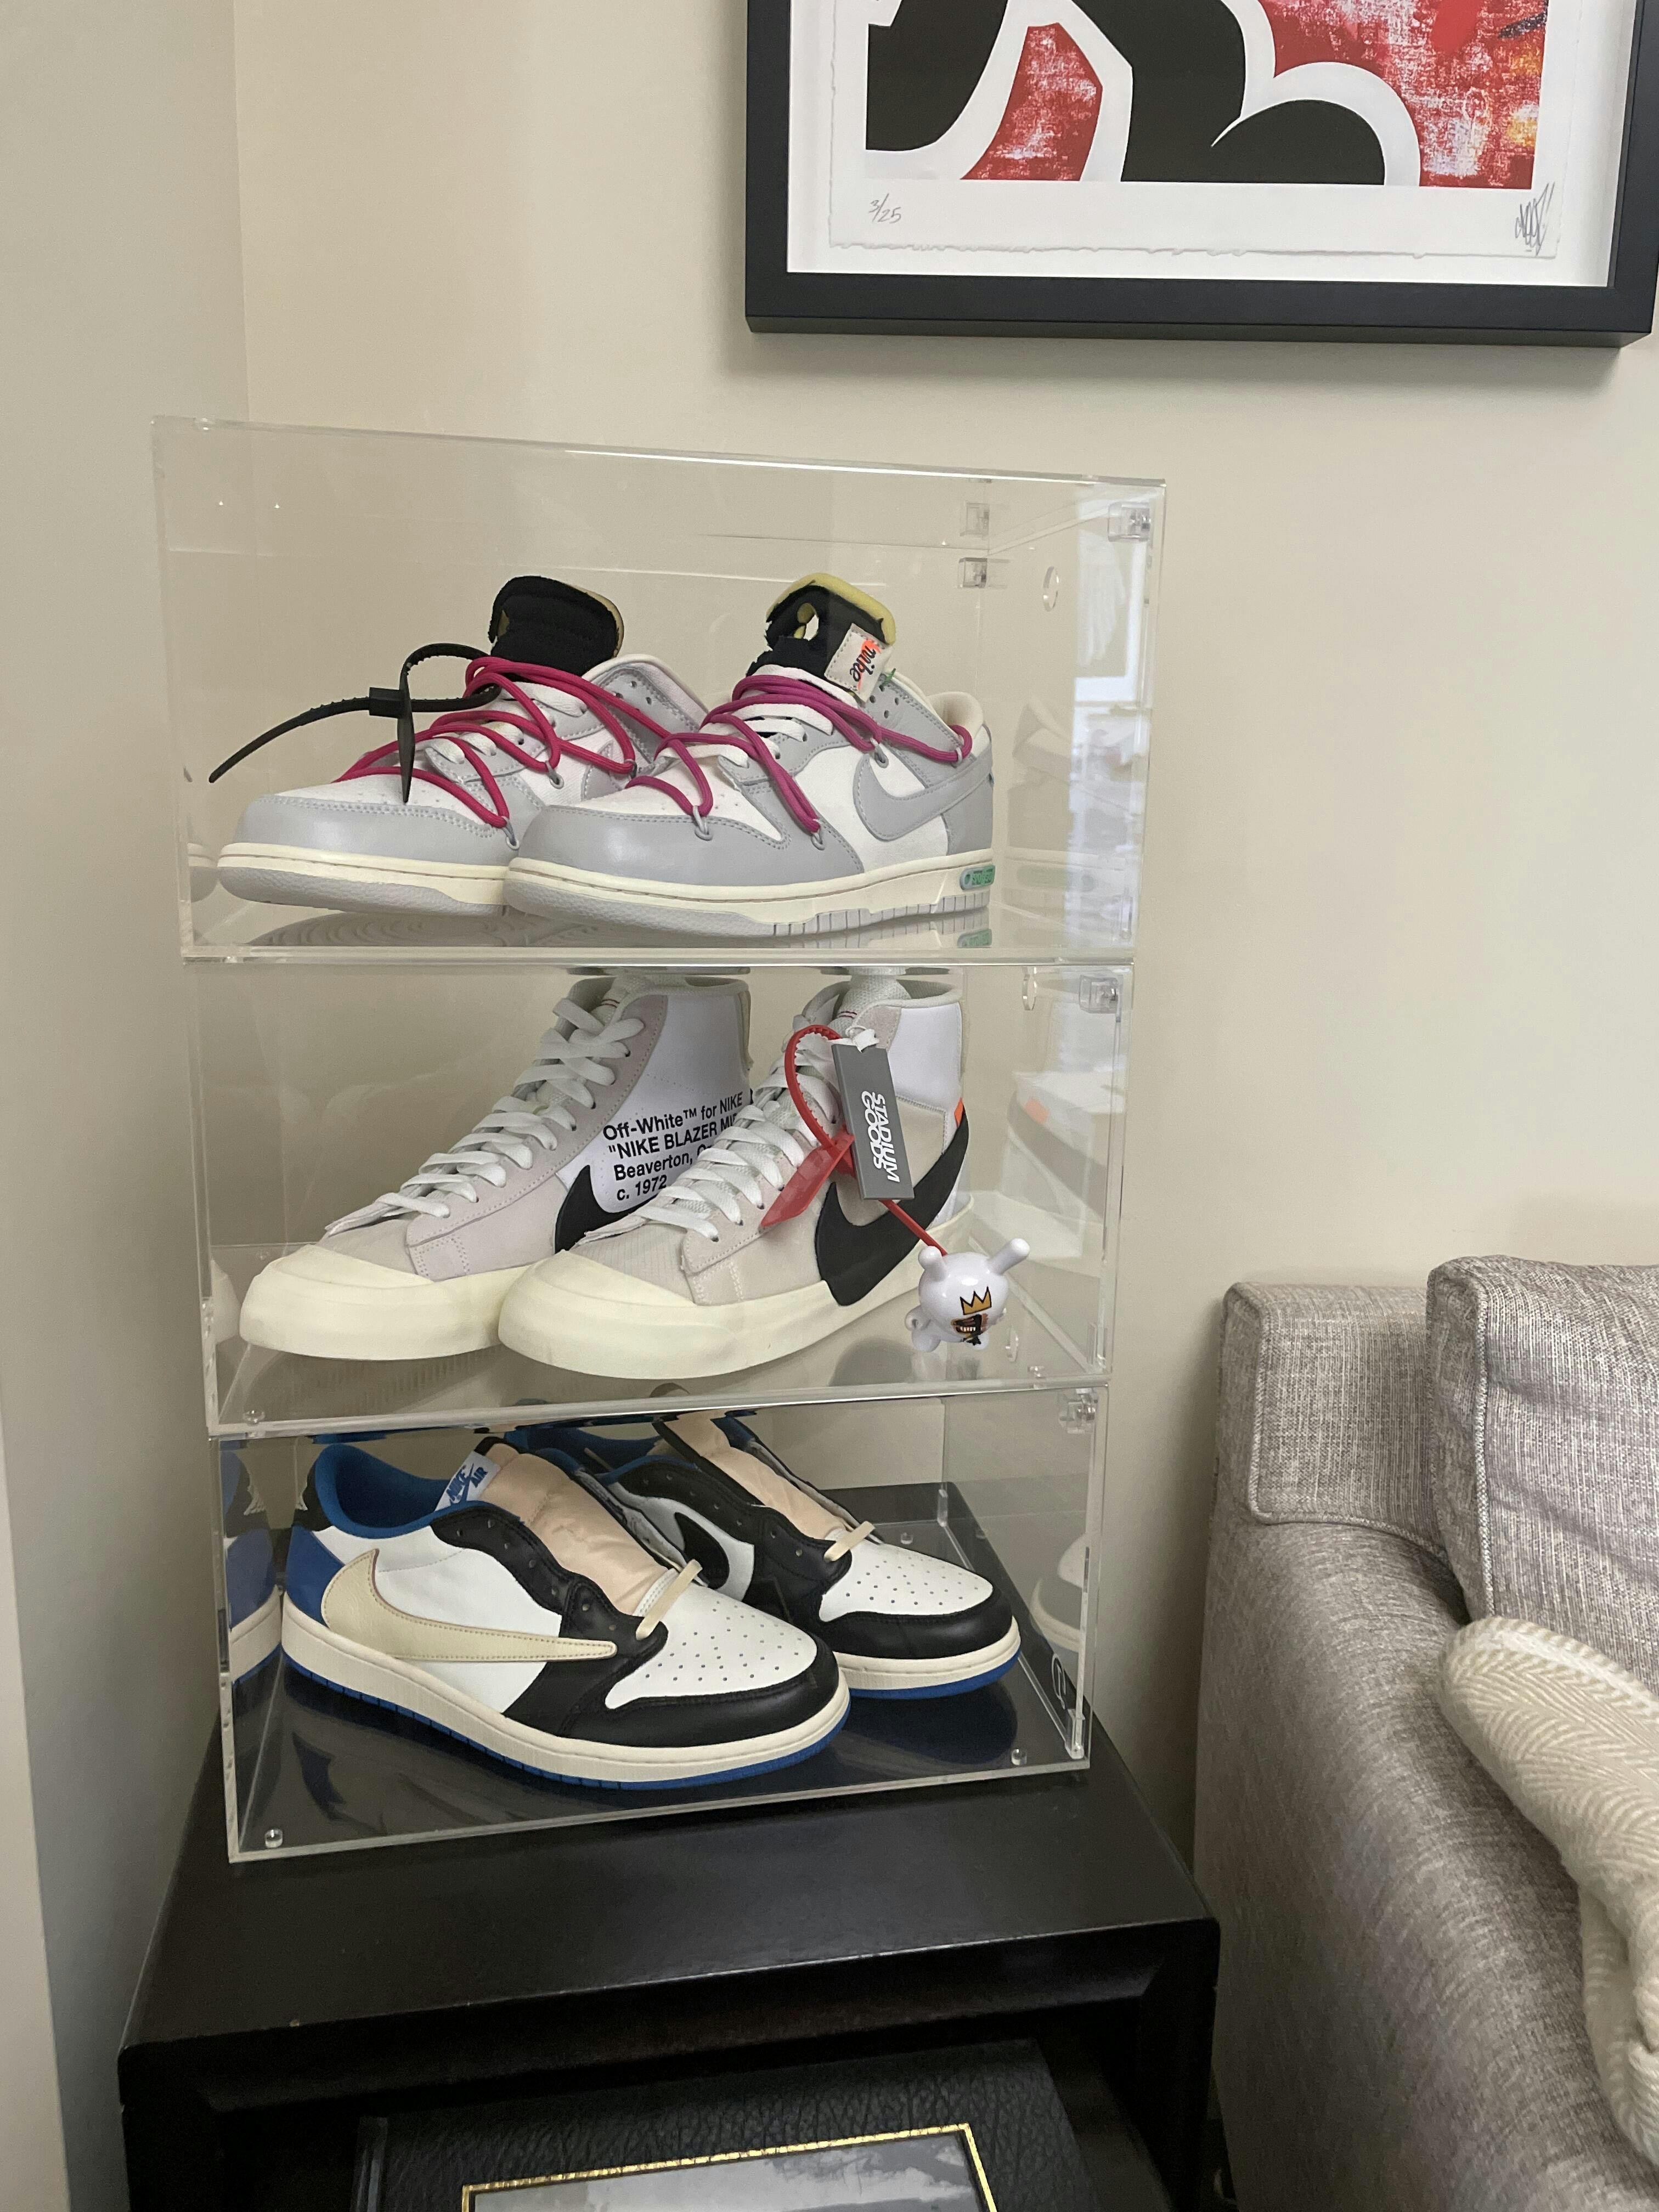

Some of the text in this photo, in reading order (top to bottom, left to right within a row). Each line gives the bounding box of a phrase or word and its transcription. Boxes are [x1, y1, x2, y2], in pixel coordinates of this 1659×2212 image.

[868, 193, 902, 224] 3/25
[701, 1104, 717, 1120] for
[720, 1091, 743, 1114] NIKE
[608, 1136, 660, 1159] "NIKE
[664, 1121, 718, 1150] BLAZER
[861, 1091, 884, 1170] GOODS
[872, 1092, 900, 1183] STADIUM
[613, 1153, 693, 1181] Beaverton,
[617, 1174, 667, 1201] c. 1972
[446, 1467, 466, 1502] NIKE
[470, 1466, 488, 1488] AIR
